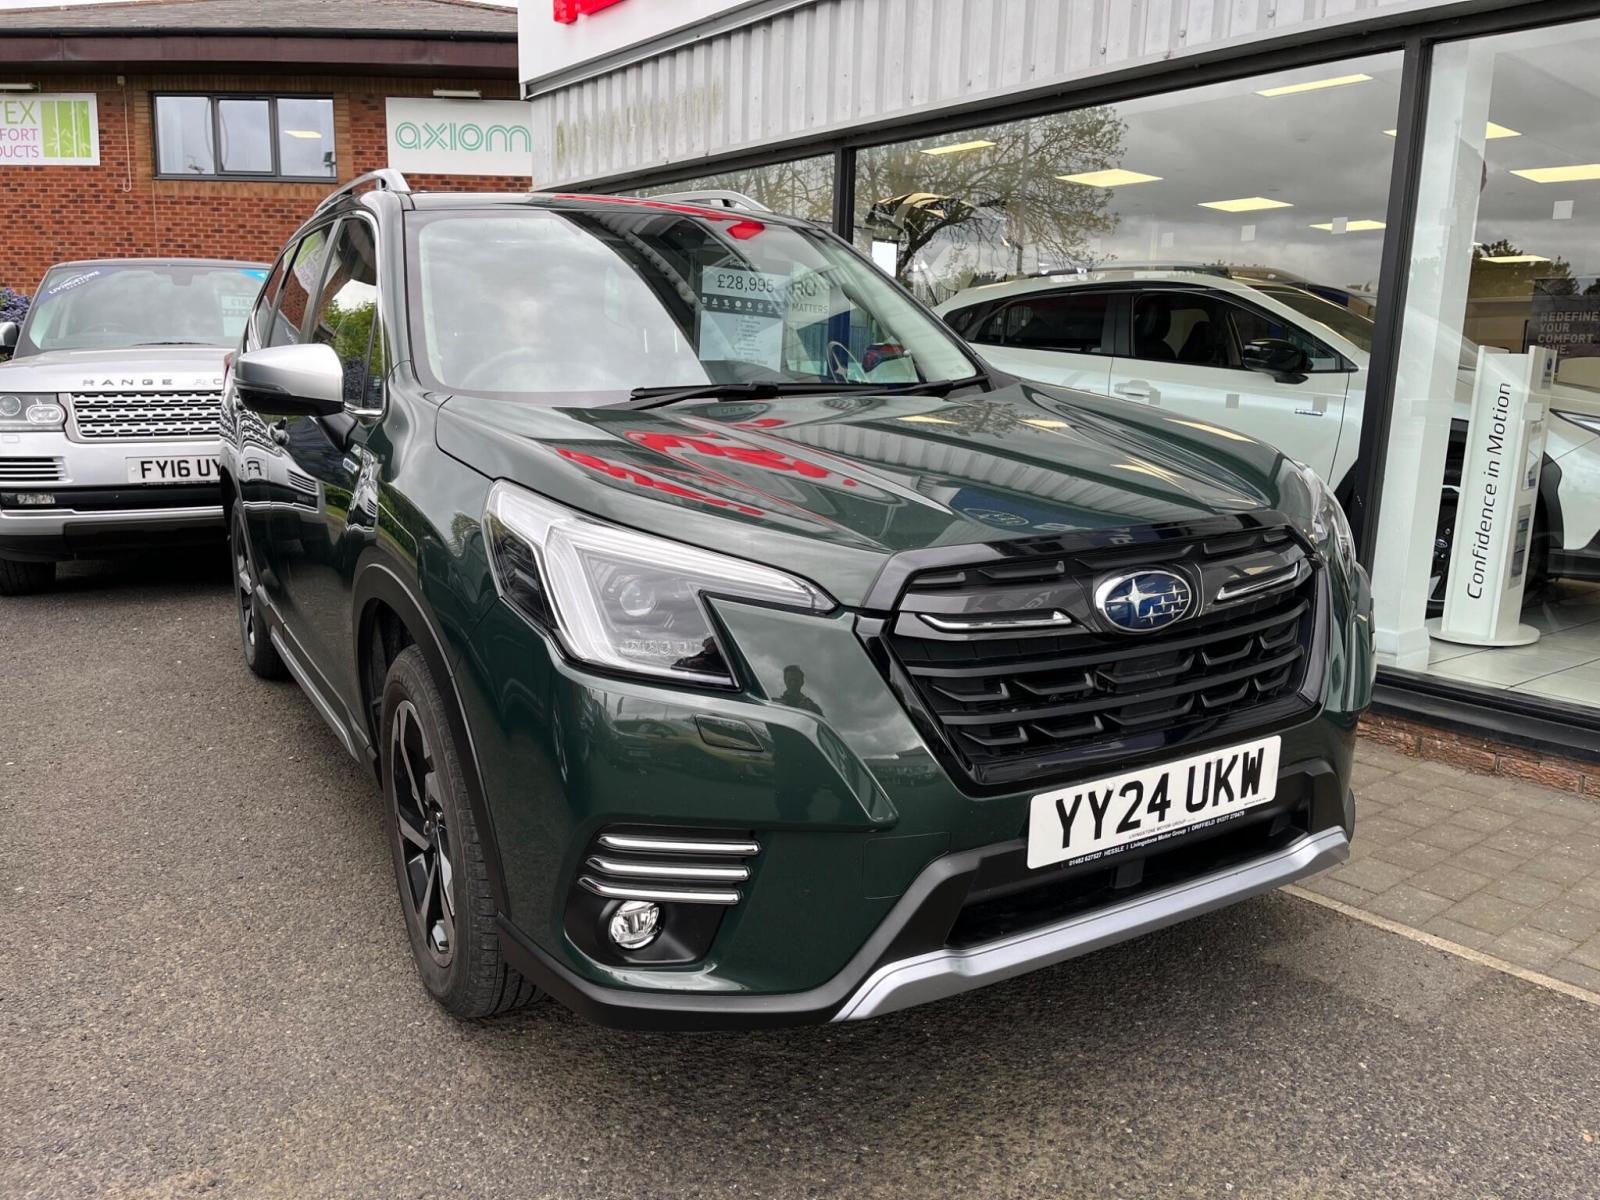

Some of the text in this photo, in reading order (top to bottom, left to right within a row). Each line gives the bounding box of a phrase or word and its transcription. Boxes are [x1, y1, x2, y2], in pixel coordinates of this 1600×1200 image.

[0, 100, 37, 125] EX
[395, 121, 532, 152] axiom
[0, 145, 40, 158] UCTS
[716, 273, 775, 293] £28,995
[1540, 311, 1600, 322] REDEFINE
[1540, 322, 1570, 333] YOUR
[1537, 333, 1594, 344] COMFORT
[82, 378, 173, 386] RANGE
[140, 459, 191, 479] FY16
[1466, 382, 1512, 599] Confidence in Motion
[1055, 747, 1265, 849] YY24 UKW
[1104, 846, 1125, 857] HESSLE
[1130, 837, 1157, 849] Livingstone
[1158, 832, 1172, 841] Motor
[1172, 827, 1187, 837] Group
[1191, 820, 1215, 831] DRIFFIELD
